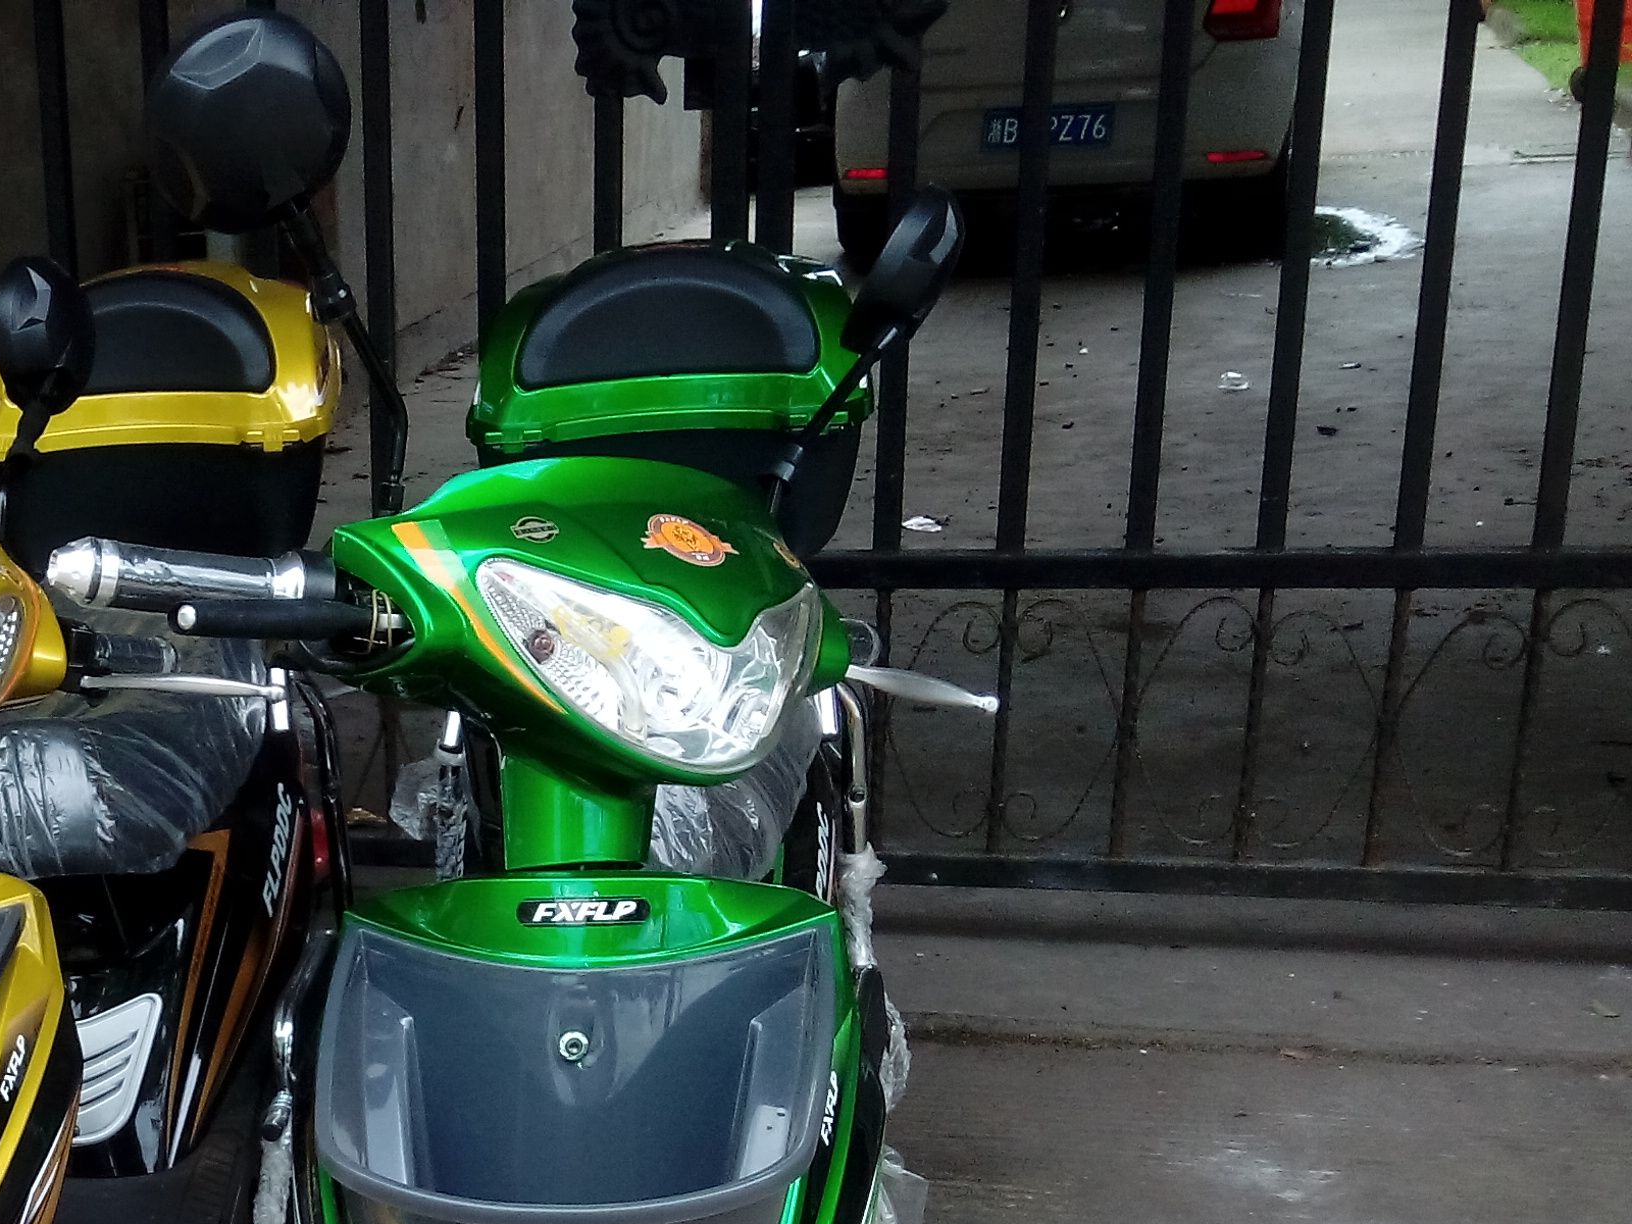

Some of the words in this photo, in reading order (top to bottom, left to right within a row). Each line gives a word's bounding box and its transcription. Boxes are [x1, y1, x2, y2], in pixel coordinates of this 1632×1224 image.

[262, 782, 292, 918] FLPDDC
[531, 900, 637, 923] FXFLP
[0, 1034, 26, 1102] FXFLP
